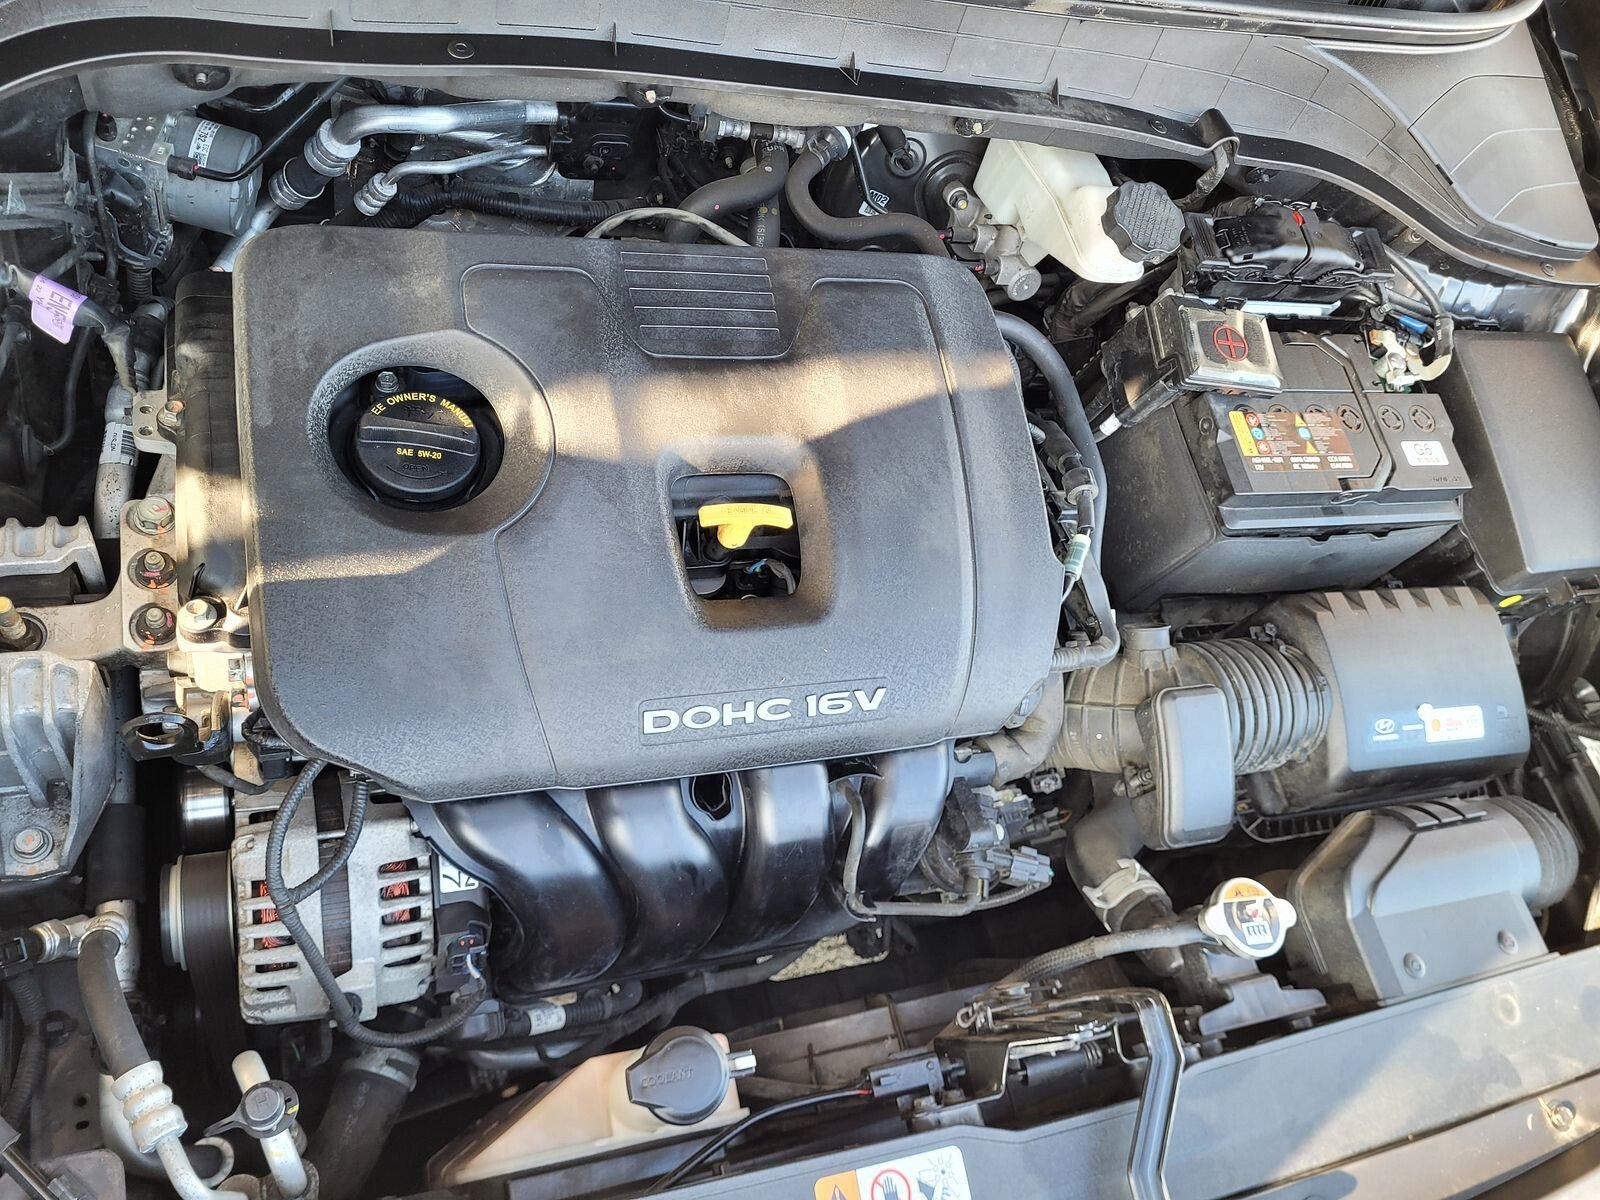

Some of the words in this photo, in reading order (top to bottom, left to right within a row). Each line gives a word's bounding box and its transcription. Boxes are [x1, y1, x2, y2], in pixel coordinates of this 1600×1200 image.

[386, 392, 437, 406] OWNER'S
[440, 399, 474, 428] MANUA
[396, 447, 414, 457] SAE
[418, 450, 442, 460] 5W-20
[642, 698, 792, 735] DOHC
[805, 686, 888, 718] 16V
[640, 1066, 695, 1089] COOLANT
